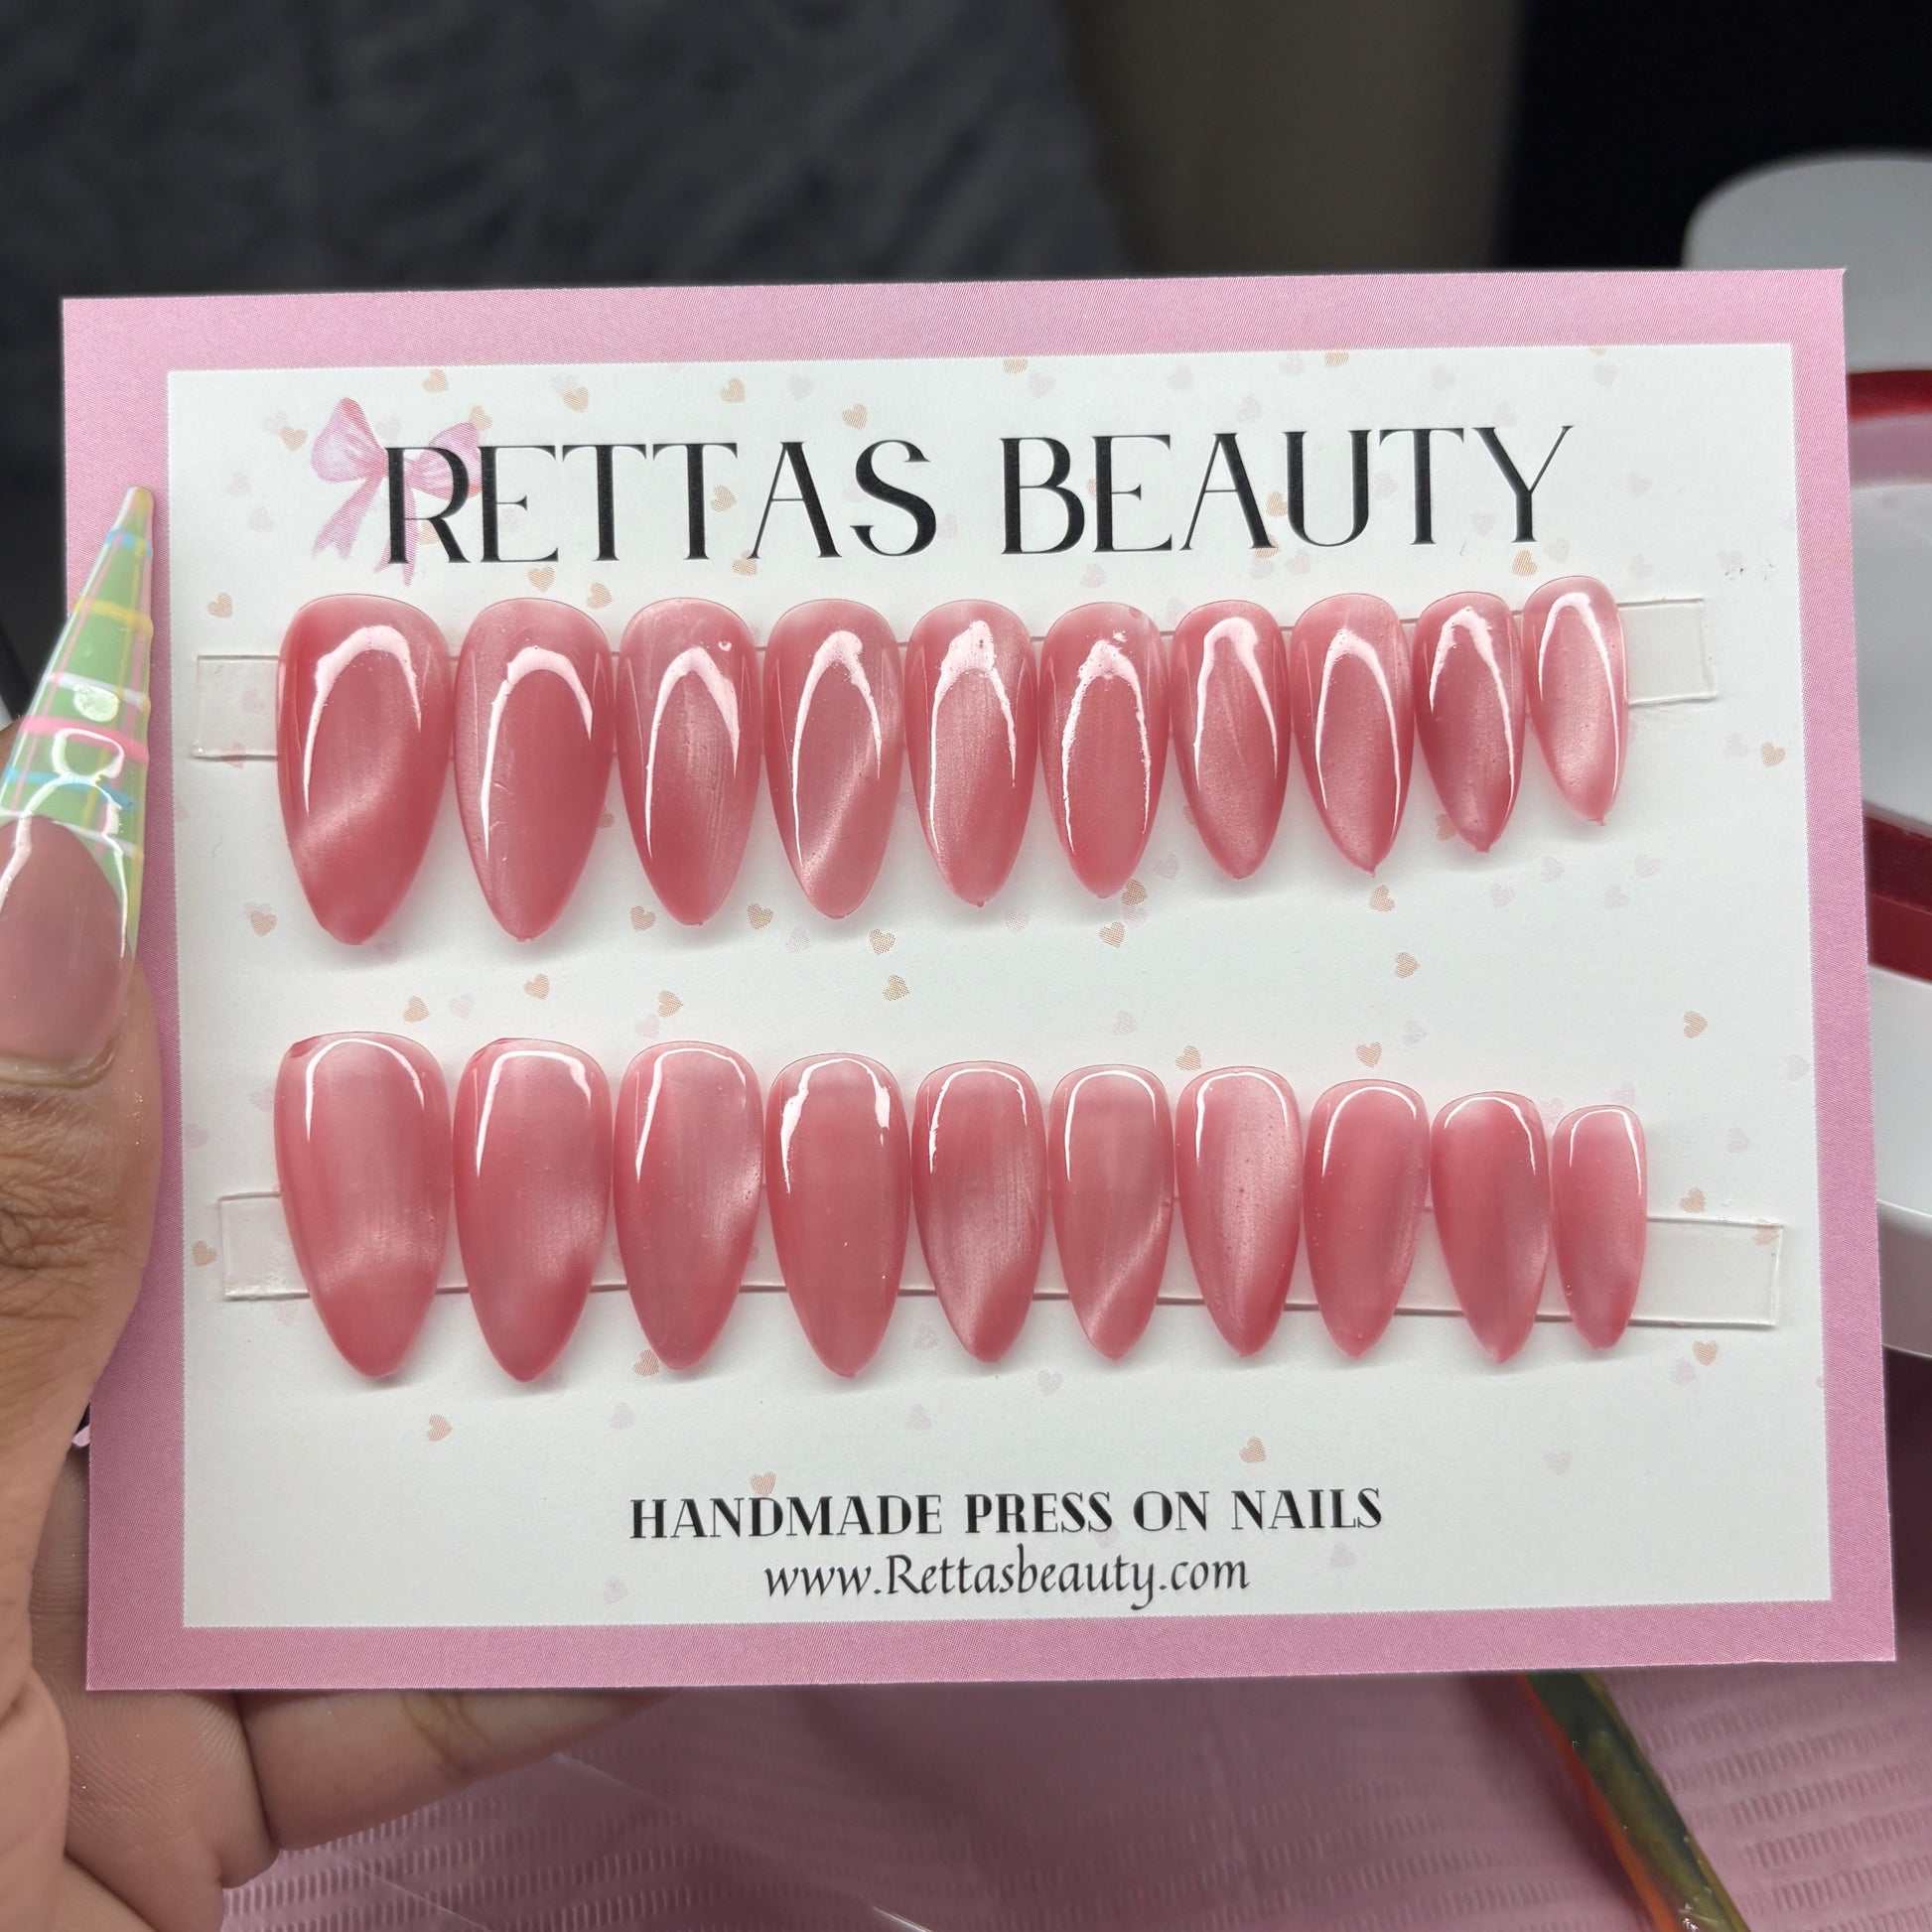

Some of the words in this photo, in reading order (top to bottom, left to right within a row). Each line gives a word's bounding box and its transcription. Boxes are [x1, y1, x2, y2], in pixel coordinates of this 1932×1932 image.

[384, 440, 937, 565] RETTAS
[1000, 425, 1574, 554] BEAUTY
[630, 1494, 942, 1539] HANDMADE
[965, 1491, 1113, 1534] PRESS
[1133, 1489, 1210, 1532] ON
[1231, 1487, 1383, 1530] NAILS
[764, 1543, 1249, 1611] www.Rettasbeauty.com
